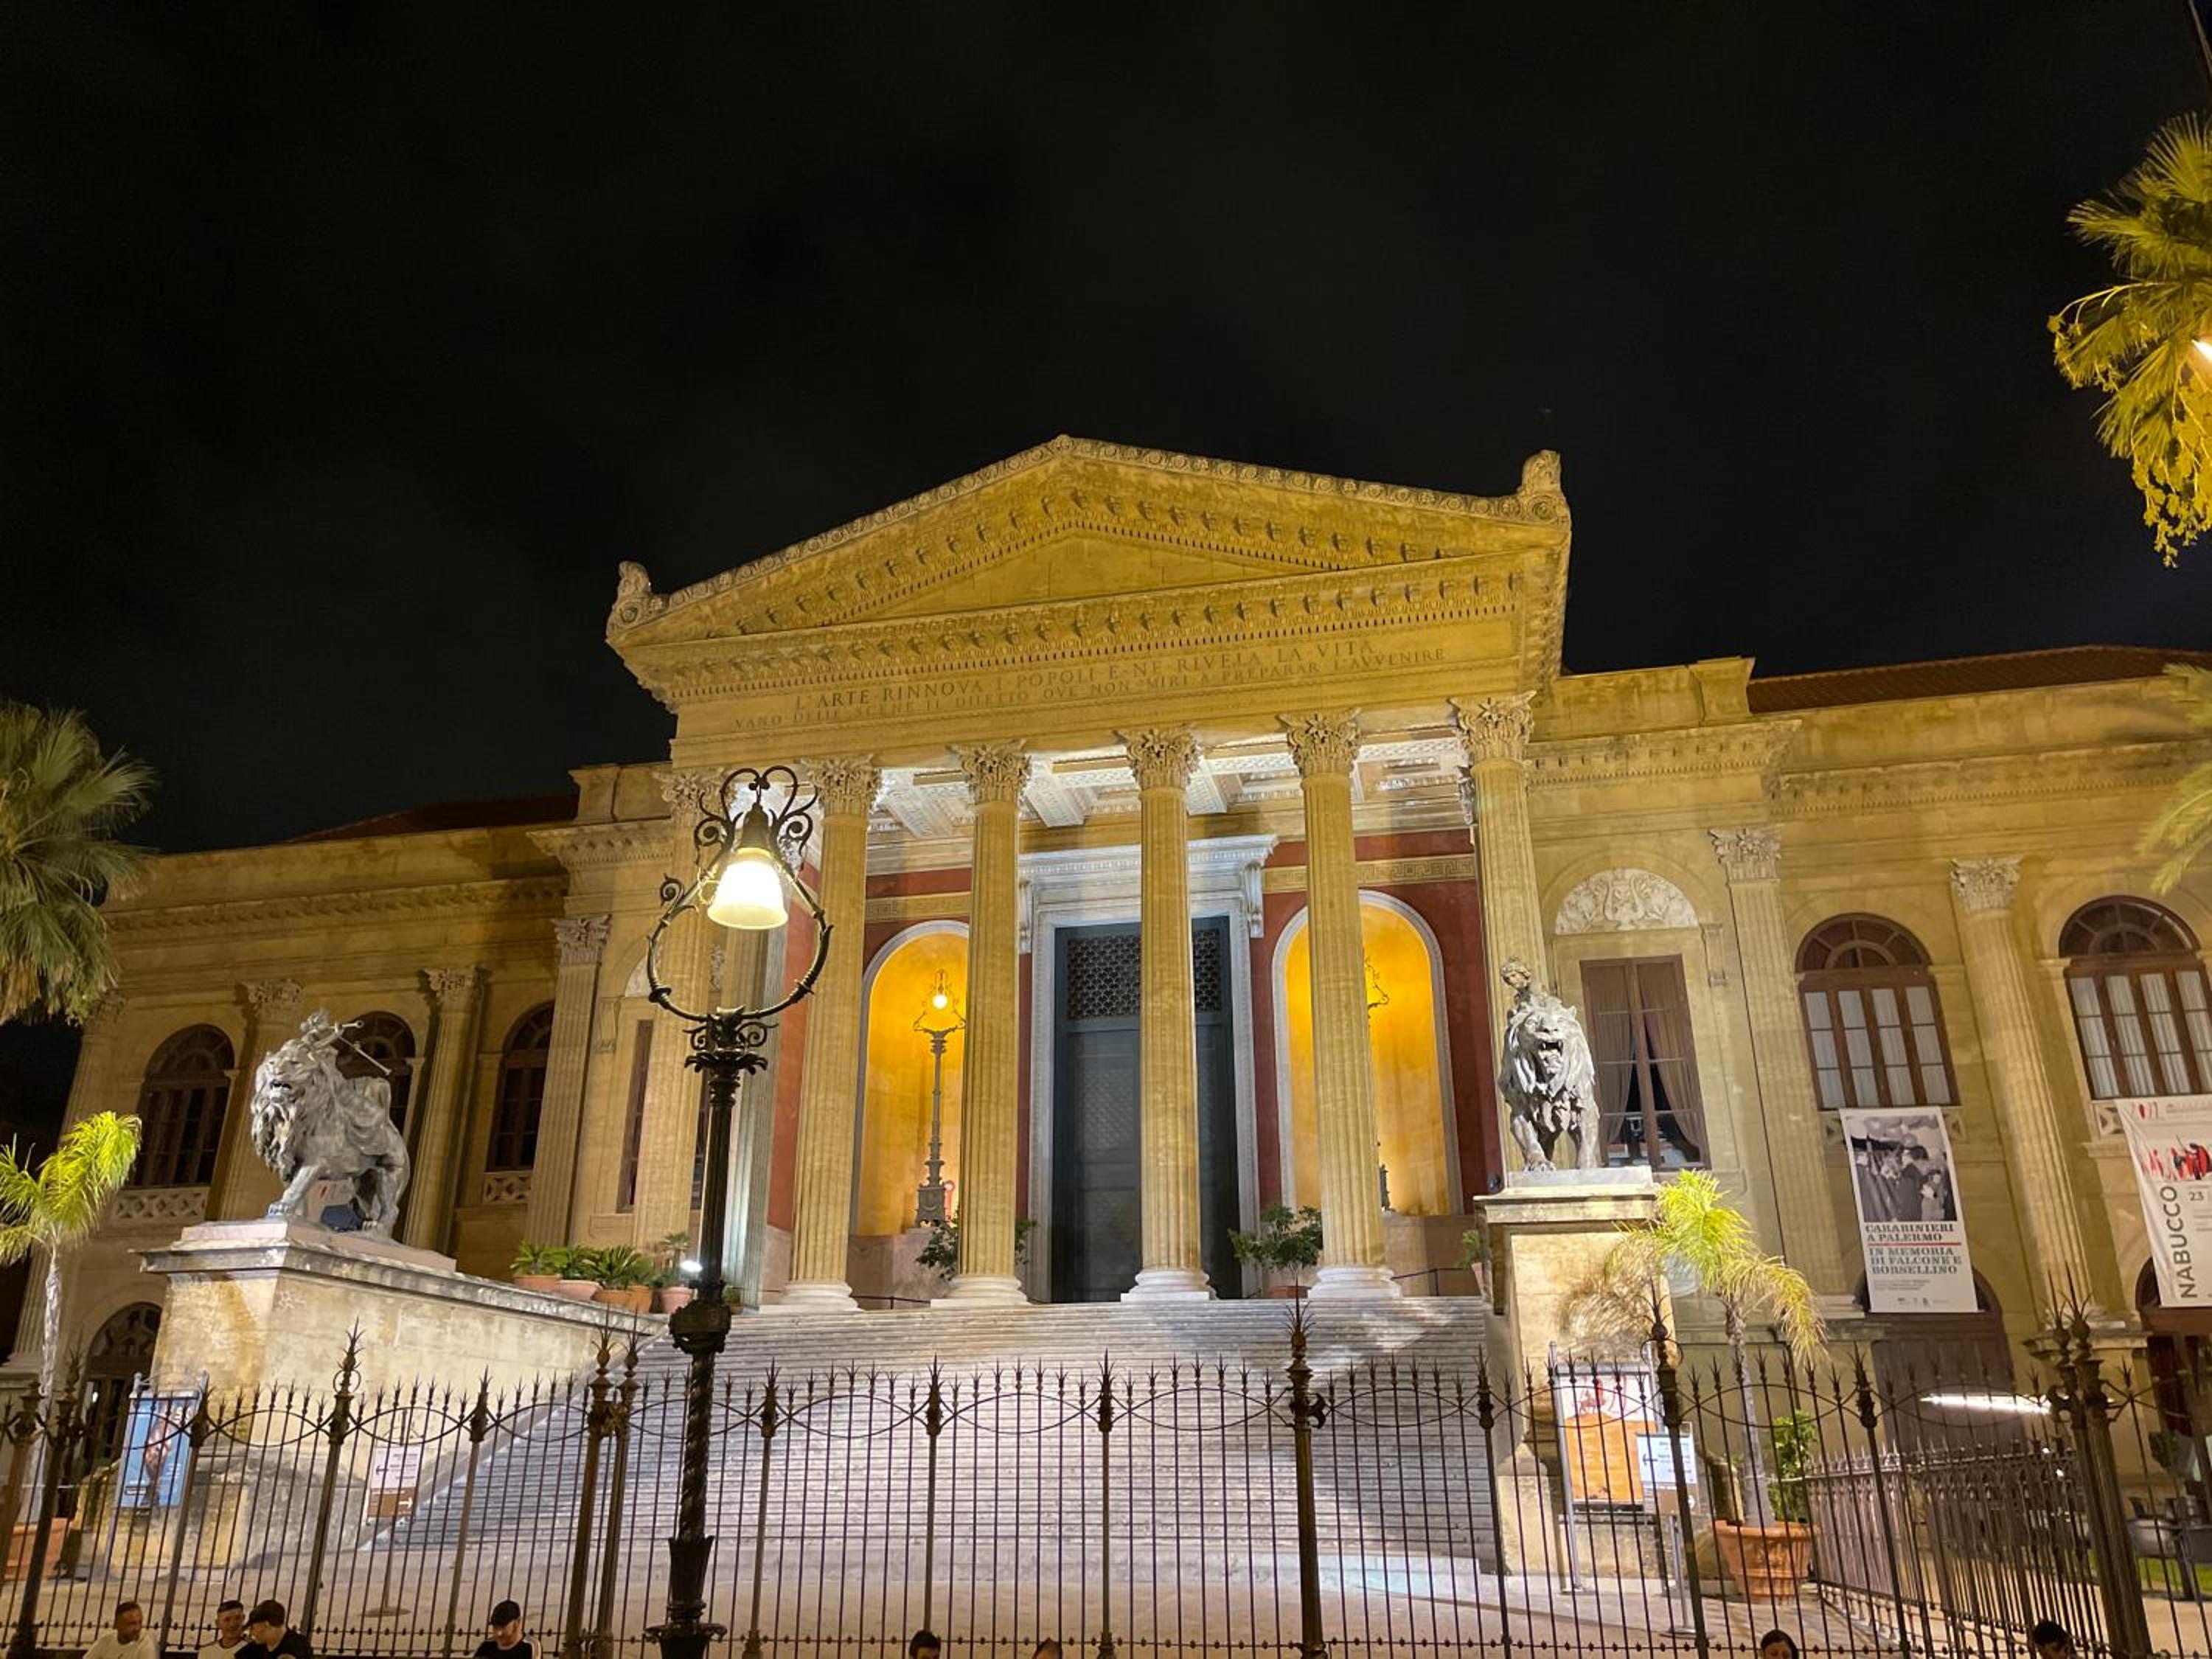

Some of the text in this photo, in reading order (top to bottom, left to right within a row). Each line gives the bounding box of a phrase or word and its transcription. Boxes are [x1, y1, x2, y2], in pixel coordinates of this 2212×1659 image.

[883, 679, 983, 700] RINNOVA
[1016, 667, 1094, 688] POPOLI
[1178, 652, 1261, 672] RIVELA
[1278, 647, 1302, 663] LA
[1317, 640, 1374, 658] VITA
[2188, 1191, 2205, 1202] 23
[1865, 1224, 1954, 1233] CARABINIERI
[1868, 1234, 1942, 1242] A PALERMO
[2160, 1186, 2198, 1298] NABUCCO
[1869, 1248, 1954, 1256] IN MEMORIA
[1871, 1256, 1962, 1265] DI FALCONE E
[1873, 1266, 1958, 1275] BORSELLINO
